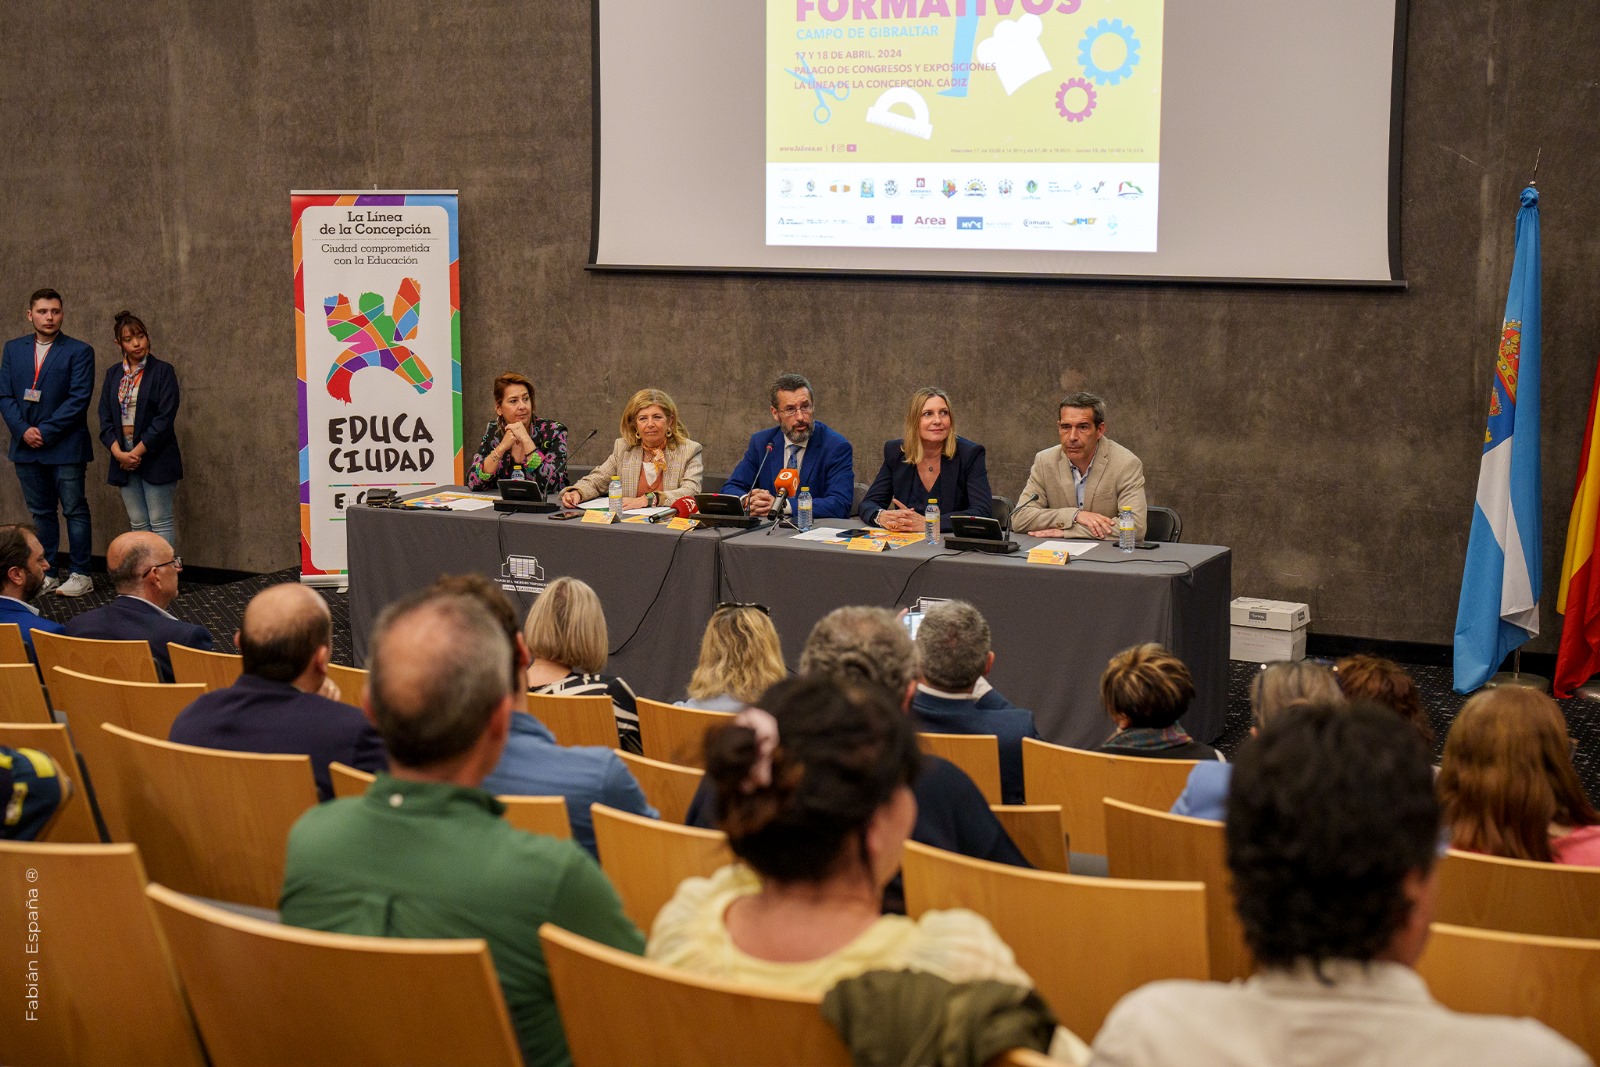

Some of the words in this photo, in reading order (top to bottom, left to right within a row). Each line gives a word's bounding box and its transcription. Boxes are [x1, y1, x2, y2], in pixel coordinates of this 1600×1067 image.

[796, 27, 843, 40] CAMPO
[848, 27, 864, 38] DE
[869, 25, 938, 38] GIBRALTAR
[795, 51, 806, 60] 17
[808, 51, 814, 60] Y
[817, 51, 828, 60] 18
[831, 50, 843, 59] DE
[845, 50, 875, 59] ABRIL.
[877, 49, 902, 58] 2024
[794, 65, 835, 75] PALACIO
[837, 65, 850, 74] DE
[852, 64, 913, 74] CONGRESOS
[914, 64, 921, 72] Y
[923, 62, 996, 72] EXPOSICIONES
[794, 81, 806, 90] LA
[837, 80, 850, 89] DE
[852, 80, 864, 89] LA
[937, 77, 968, 87] CÁDIZ
[347, 211, 364, 222] La
[367, 211, 403, 222] Línea
[914, 216, 946, 226] Area
[319, 224, 336, 235] de
[339, 224, 352, 235] la
[354, 223, 431, 237] Concepción
[321, 243, 358, 253] Ciudad
[360, 243, 431, 255] comprometida
[354, 256, 364, 265] la
[367, 255, 419, 265] Educación
[328, 413, 434, 445] EDUCA
[328, 447, 435, 474] CIUDAD
